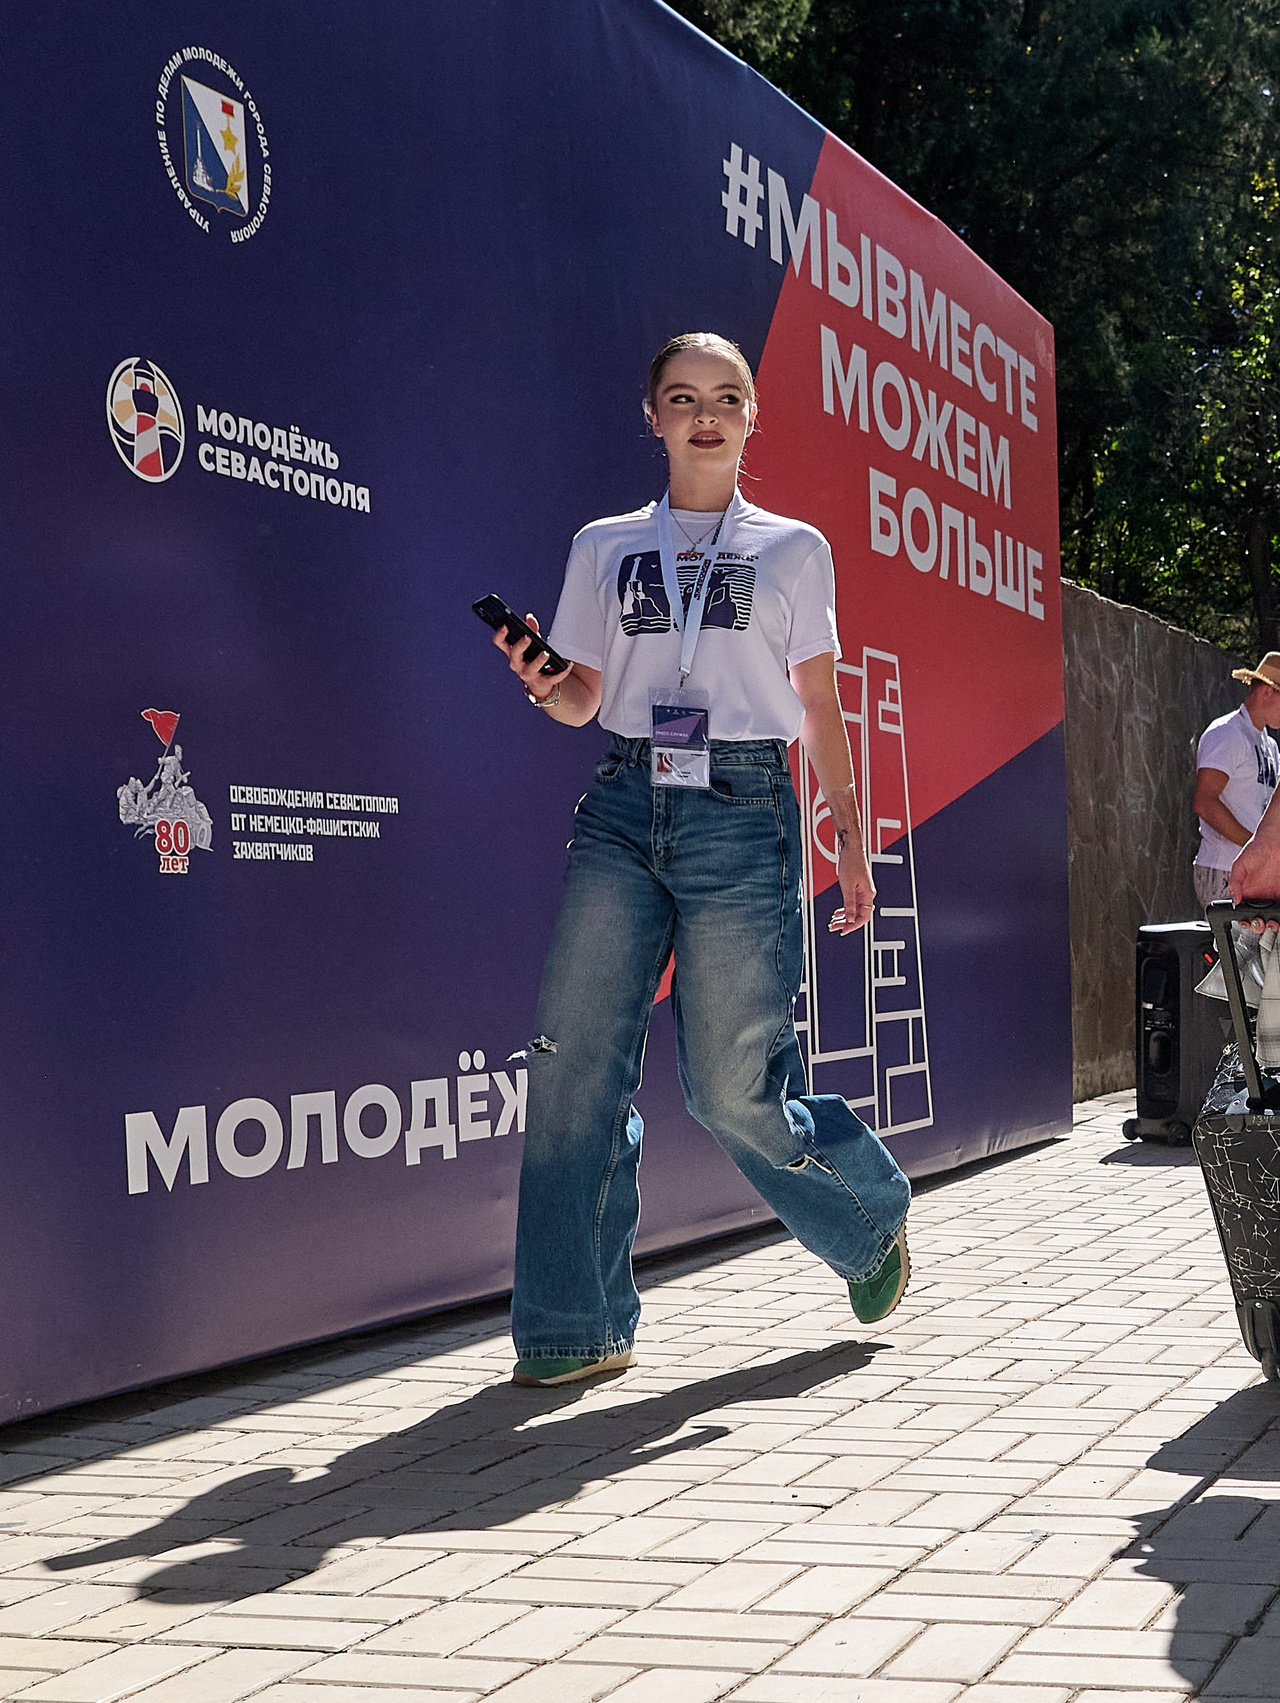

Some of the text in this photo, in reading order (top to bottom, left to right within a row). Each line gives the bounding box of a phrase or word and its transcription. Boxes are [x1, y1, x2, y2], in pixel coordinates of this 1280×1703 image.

[155, 46, 272, 244] УПРАВЛЕНИЕ ПО ДЕЛАМ МОЛОДЕЖИ ГОРОДА СЕВАСТОПОЛЯ
[721, 142, 1039, 434] #МЫВМЕСТЕ
[196, 404, 340, 470] МОЛОДЁЖЬ
[820, 324, 1012, 510] МОЖЕМ
[198, 442, 371, 513] СЕВАСТОПОЛЯ
[868, 466, 1045, 621] БОЛЬШЕ
[229, 784, 399, 814] ОСВОБОЖДЕНИЯ СЕВАСТОПОЛЯ
[230, 813, 380, 838] ОТ НЕМЕЦКО-ФАШИСТСКИХ
[155, 819, 191, 855] 80
[160, 855, 190, 874] лет
[232, 840, 314, 862] ЗАХВАТЧИКОВ
[124, 1049, 529, 1196] МОЛОДЁЖ
